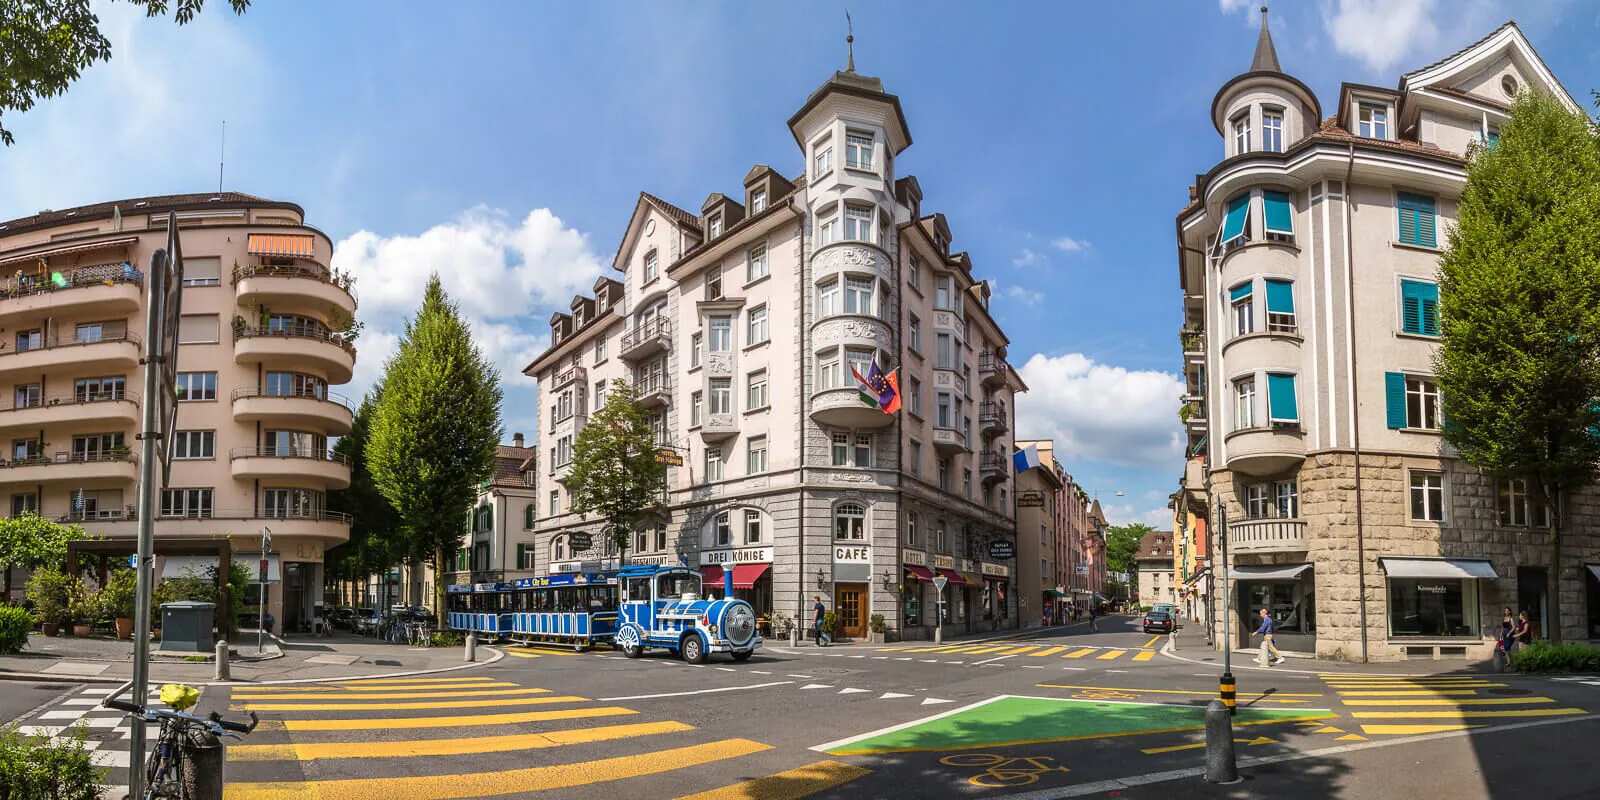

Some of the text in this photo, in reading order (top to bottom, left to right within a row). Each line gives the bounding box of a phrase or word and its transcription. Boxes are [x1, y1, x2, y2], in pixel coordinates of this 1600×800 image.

[709, 550, 764, 562] DREI KÖNIGE
[836, 546, 868, 560] CAFÉ
[632, 556, 667, 566] RESTAURANT
